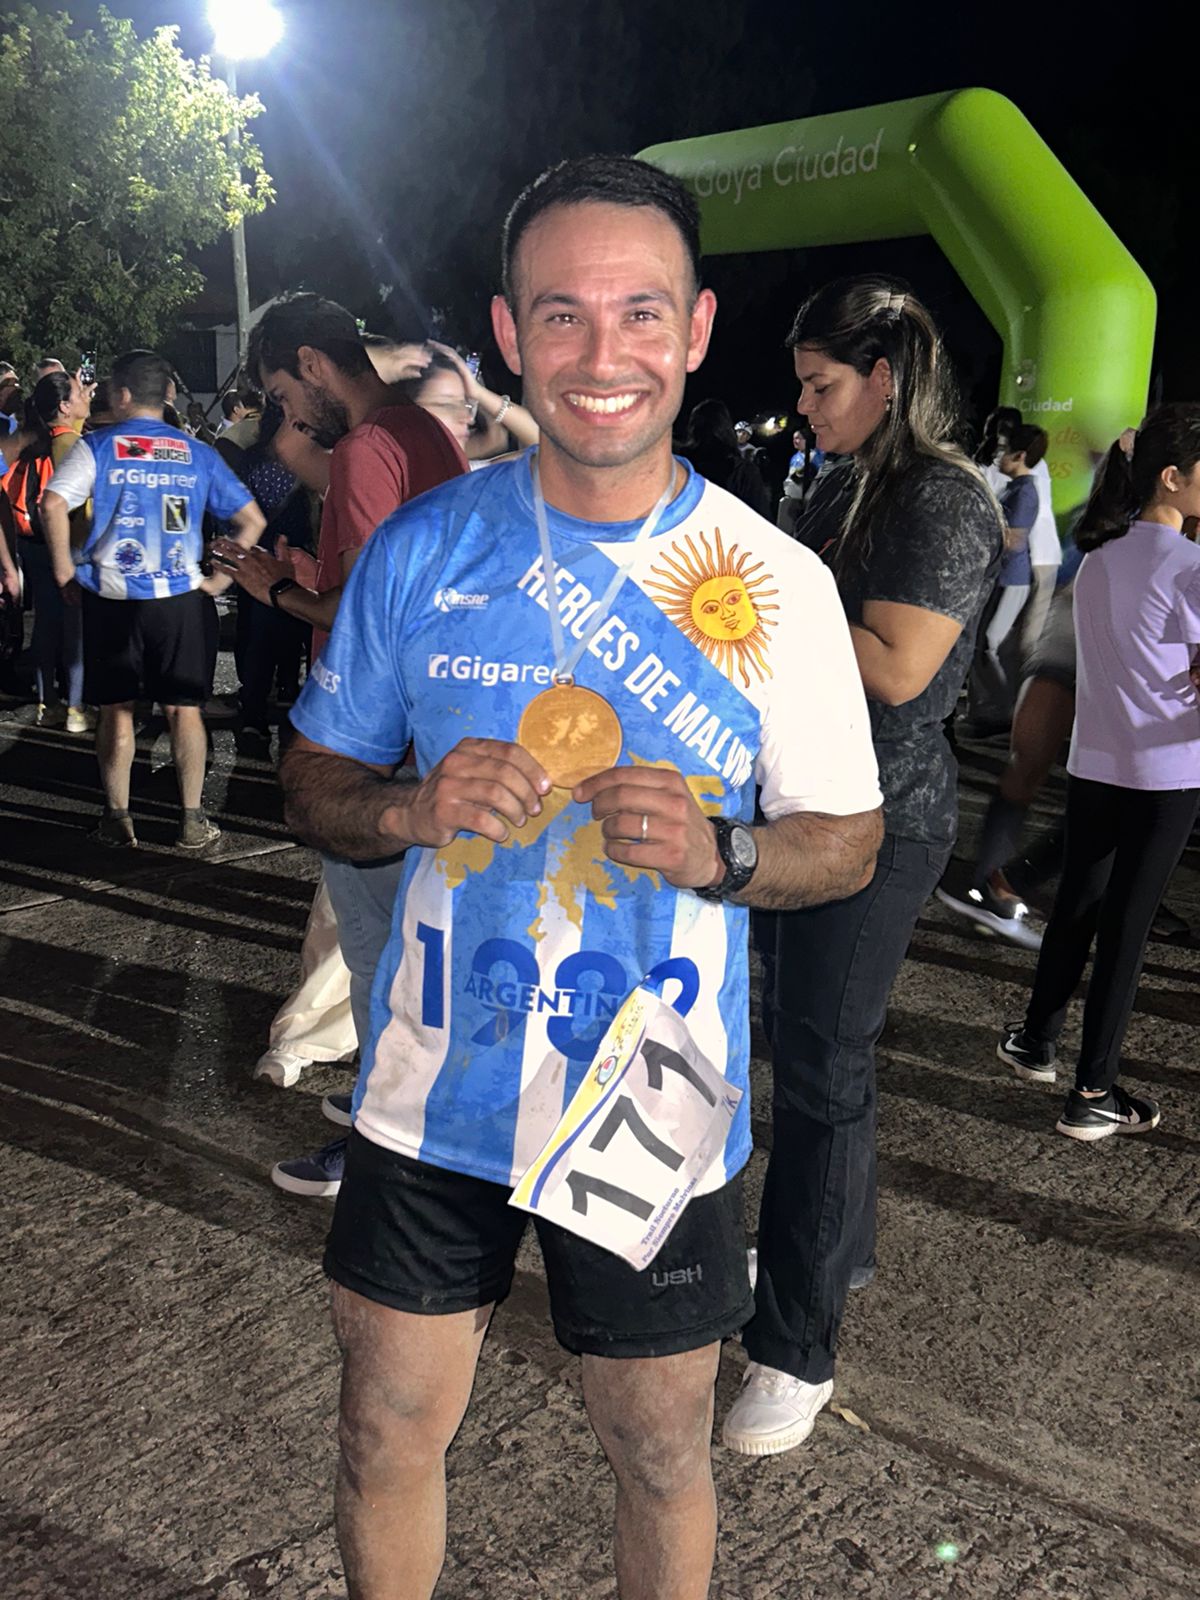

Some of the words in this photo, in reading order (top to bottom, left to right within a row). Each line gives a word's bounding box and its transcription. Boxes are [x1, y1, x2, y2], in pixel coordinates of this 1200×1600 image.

[694, 159, 762, 205] Goya
[773, 127, 885, 186] Ciudad
[1020, 397, 1073, 412] Ciudad
[126, 468, 198, 489] Gigared
[517, 554, 640, 672] HEROES
[623, 652, 682, 713] DE
[463, 974, 621, 1018] ARGENTIN
[565, 1037, 717, 1222] 171
[653, 1187, 680, 1224] Nocturno
[652, 1212, 677, 1247] Siempre
